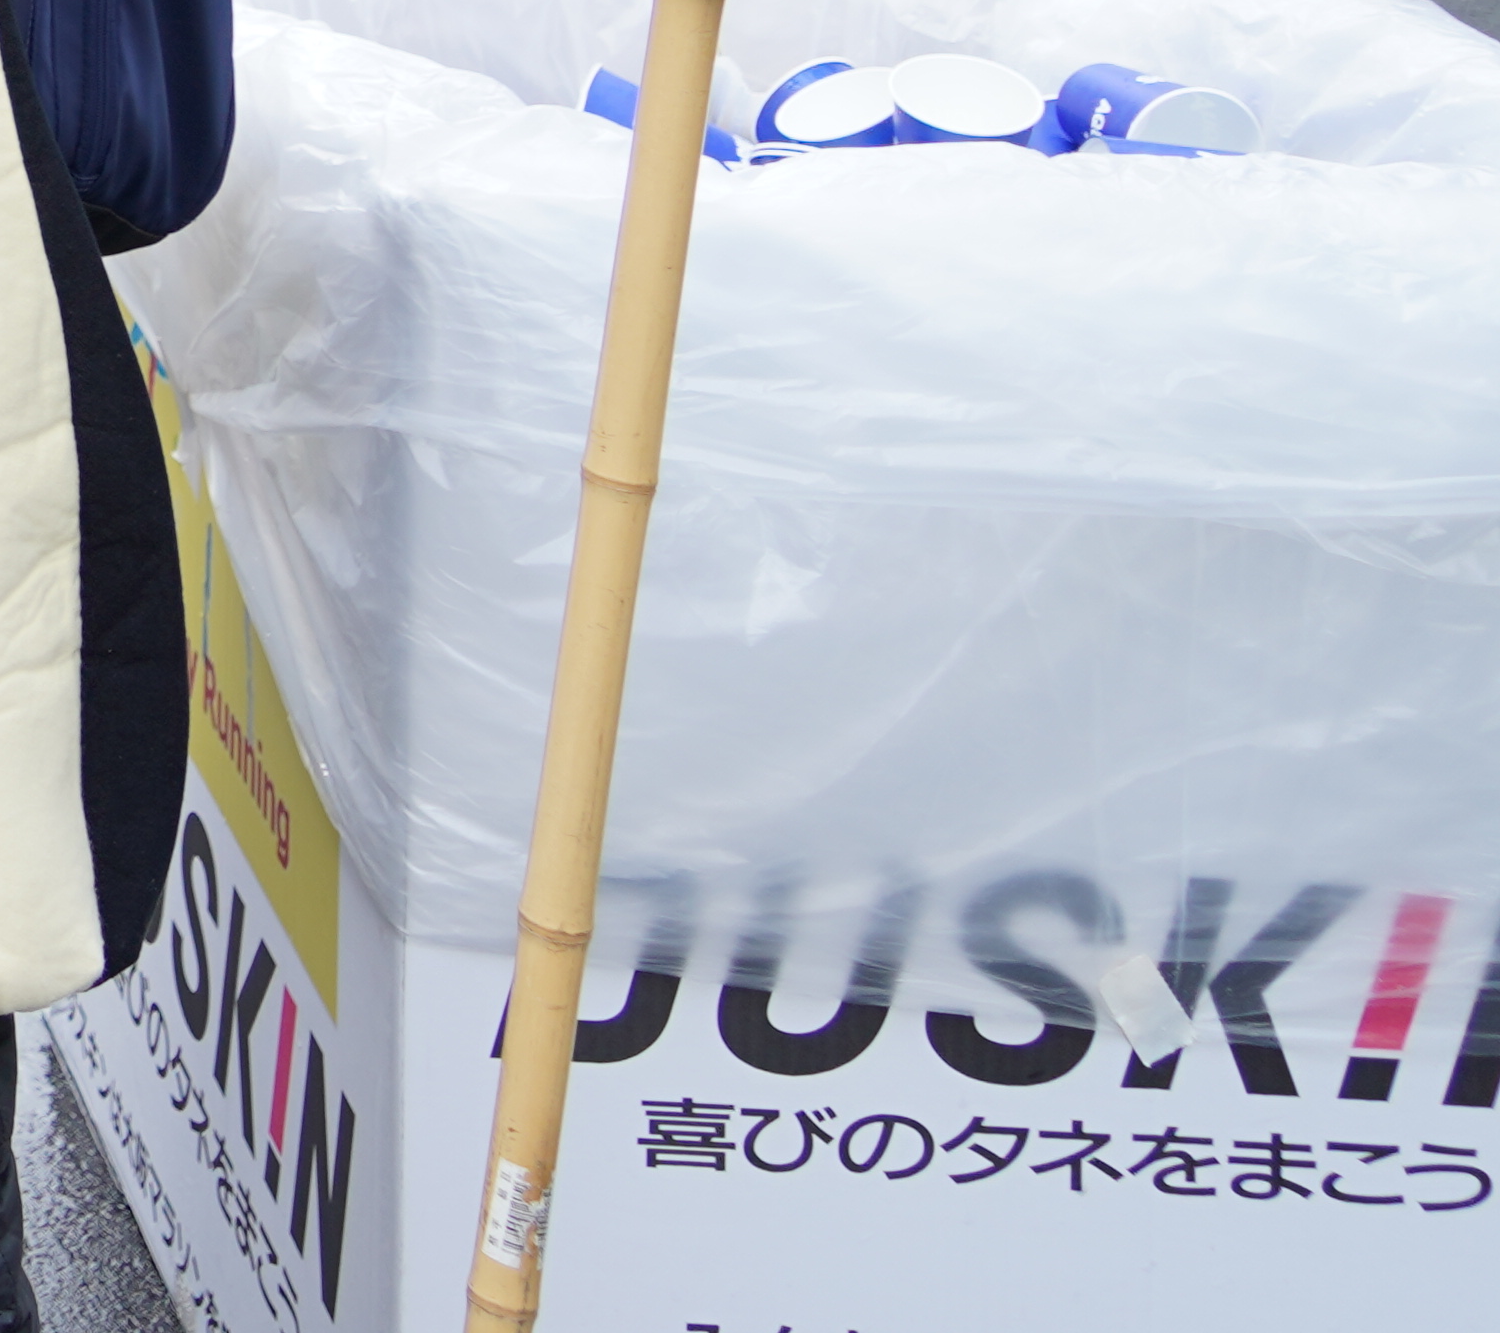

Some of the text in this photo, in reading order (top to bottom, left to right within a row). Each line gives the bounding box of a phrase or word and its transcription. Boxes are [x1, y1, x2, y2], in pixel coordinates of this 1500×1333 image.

[202, 655, 291, 870] Running
[637, 1095, 1491, 1213] 喜びのタネをまこう
